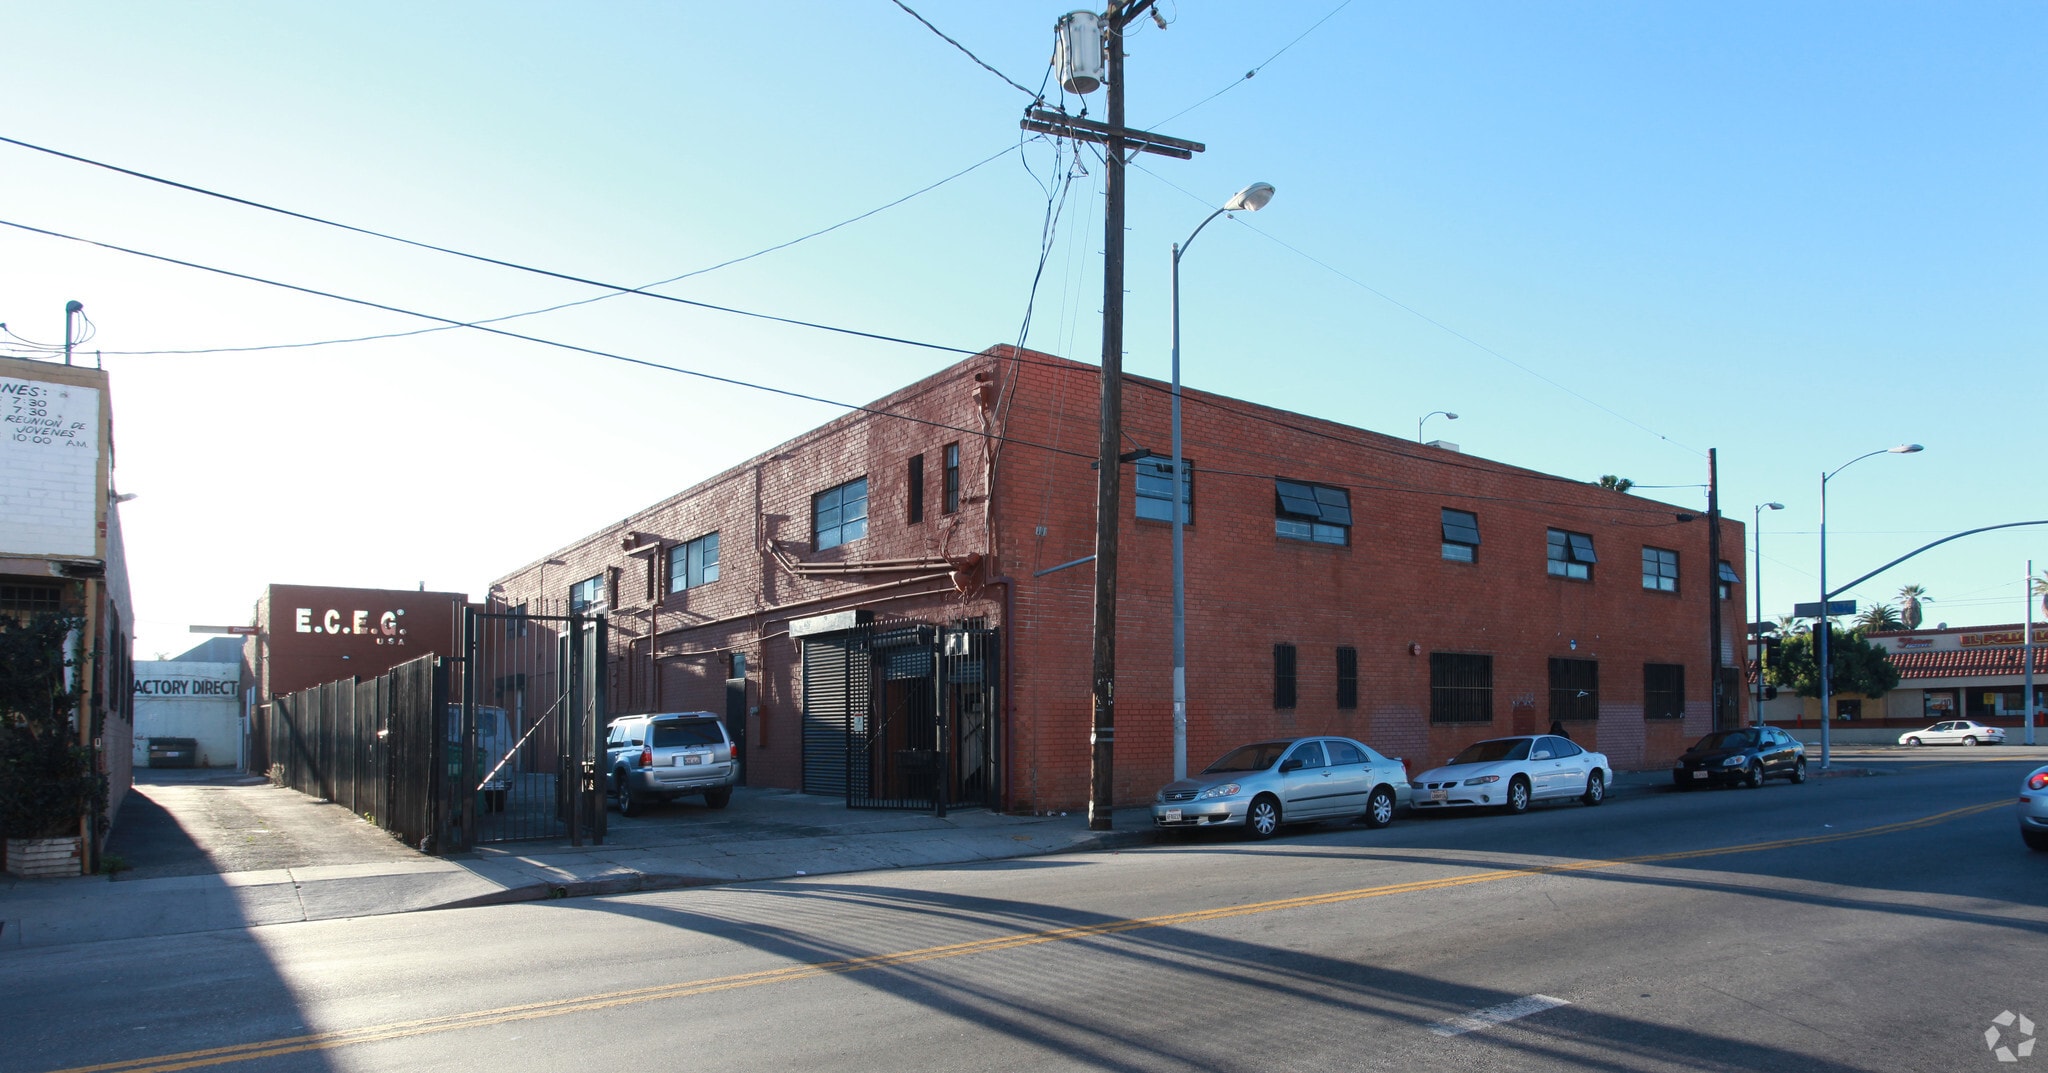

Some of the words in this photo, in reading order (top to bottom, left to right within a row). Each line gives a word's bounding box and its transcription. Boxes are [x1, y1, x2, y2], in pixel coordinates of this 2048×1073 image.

[0, 383, 47, 397] NES:
[12, 396, 47, 408] 7:30
[12, 405, 47, 417] 7:30
[4, 414, 62, 428] REUNION
[71, 421, 86, 430] DE
[16, 426, 75, 438] JOVENES
[13, 433, 52, 445] 10:00
[1960, 635, 1982, 647] EL
[1982, 632, 2025, 645] POLLO
[192, 680, 238, 695] DIRECT
